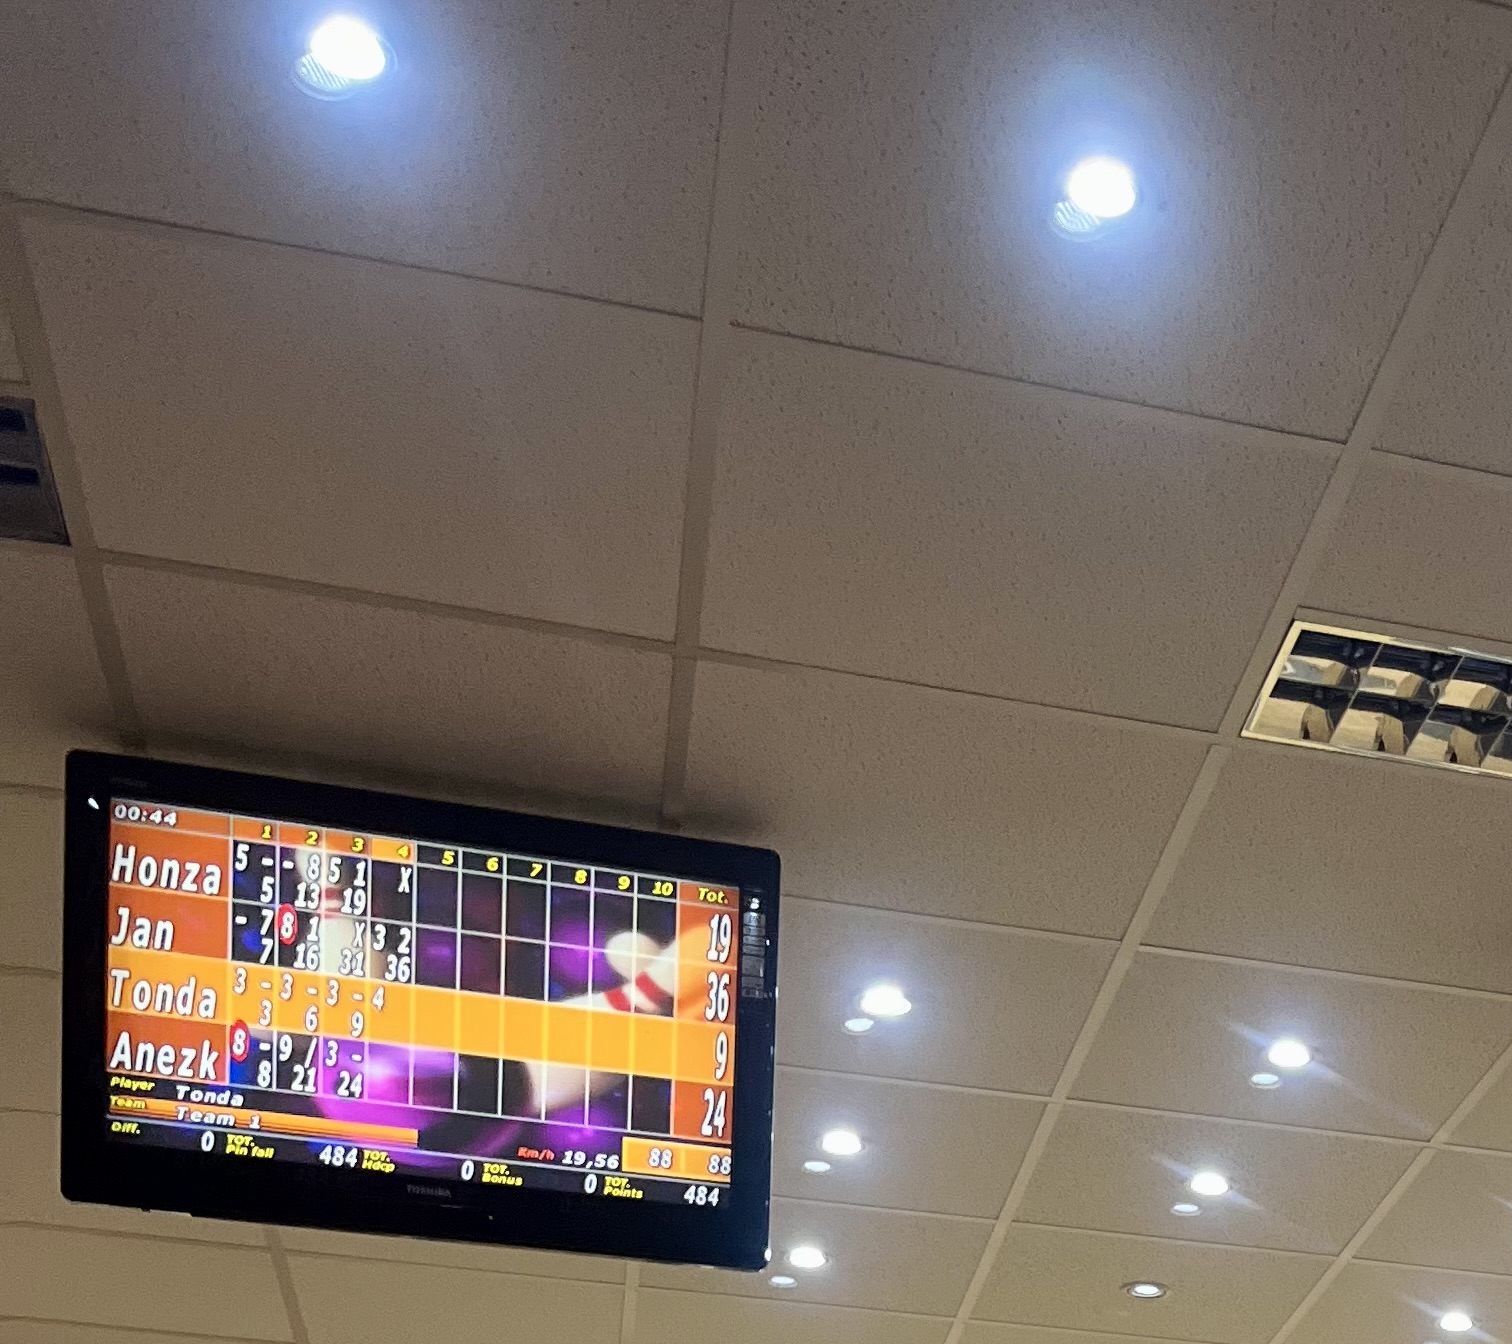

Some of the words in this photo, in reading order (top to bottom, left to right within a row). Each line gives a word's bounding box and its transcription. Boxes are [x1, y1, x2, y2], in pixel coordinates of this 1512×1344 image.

[114, 803, 177, 828] 00:44
[111, 842, 222, 896] Honza
[294, 881, 321, 910] 13
[340, 888, 366, 916] 19
[706, 912, 733, 963] 19
[697, 887, 729, 904] Tot.
[110, 906, 175, 951] Jan
[385, 954, 411, 983] 36
[704, 971, 731, 1021] 36
[110, 968, 218, 1019] Tonda
[714, 1031, 729, 1080] 9
[109, 1031, 219, 1081] Anezk
[290, 1064, 317, 1093] 21
[336, 1070, 364, 1099] 24
[701, 1087, 726, 1138] 24
[110, 1076, 156, 1092] Player
[176, 1084, 245, 1108] Tonda
[110, 1095, 147, 1110] Team
[176, 1106, 236, 1127] Team
[110, 1121, 141, 1135] Diff.
[226, 1144, 248, 1156] Pin
[251, 1146, 274, 1159] fall
[318, 1144, 358, 1168] 484
[517, 1146, 555, 1161] Km/h
[562, 1149, 620, 1170] 19,56
[648, 1147, 674, 1169] 88
[481, 1173, 523, 1186] Bonus
[603, 1186, 644, 1200] Points
[683, 1185, 720, 1207] 484
